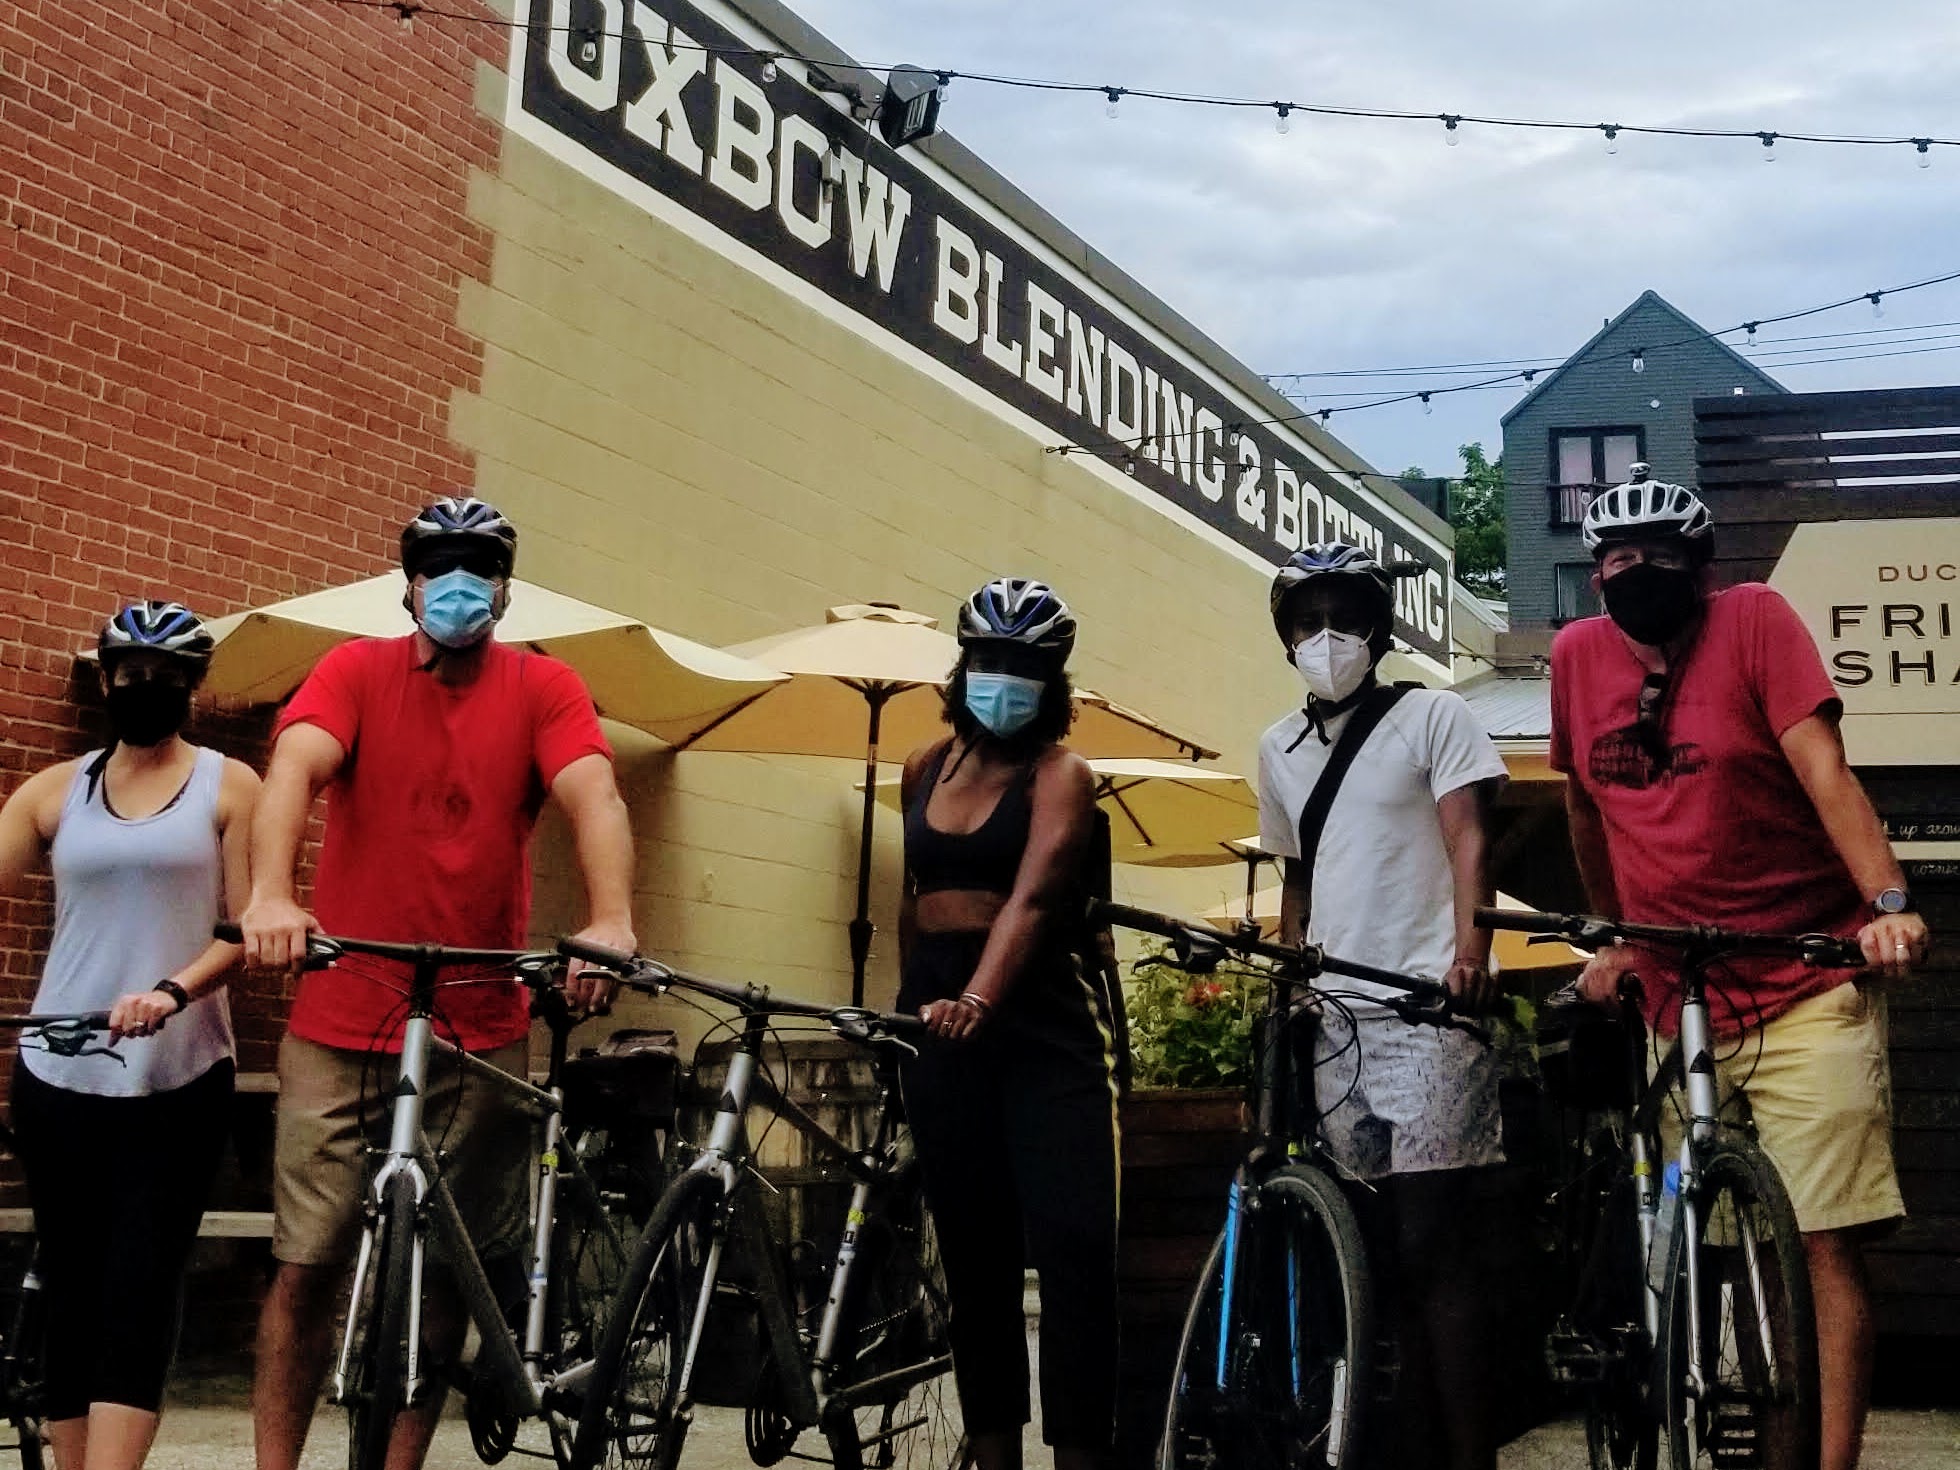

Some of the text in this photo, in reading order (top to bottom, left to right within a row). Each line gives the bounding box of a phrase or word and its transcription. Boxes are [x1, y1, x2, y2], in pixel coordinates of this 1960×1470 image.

[547, 0, 912, 294] OXBOW
[933, 215, 1226, 503] BLENDING
[1236, 433, 1266, 532] &
[1878, 564, 1957, 582] DUC
[1830, 603, 1951, 640] FRI
